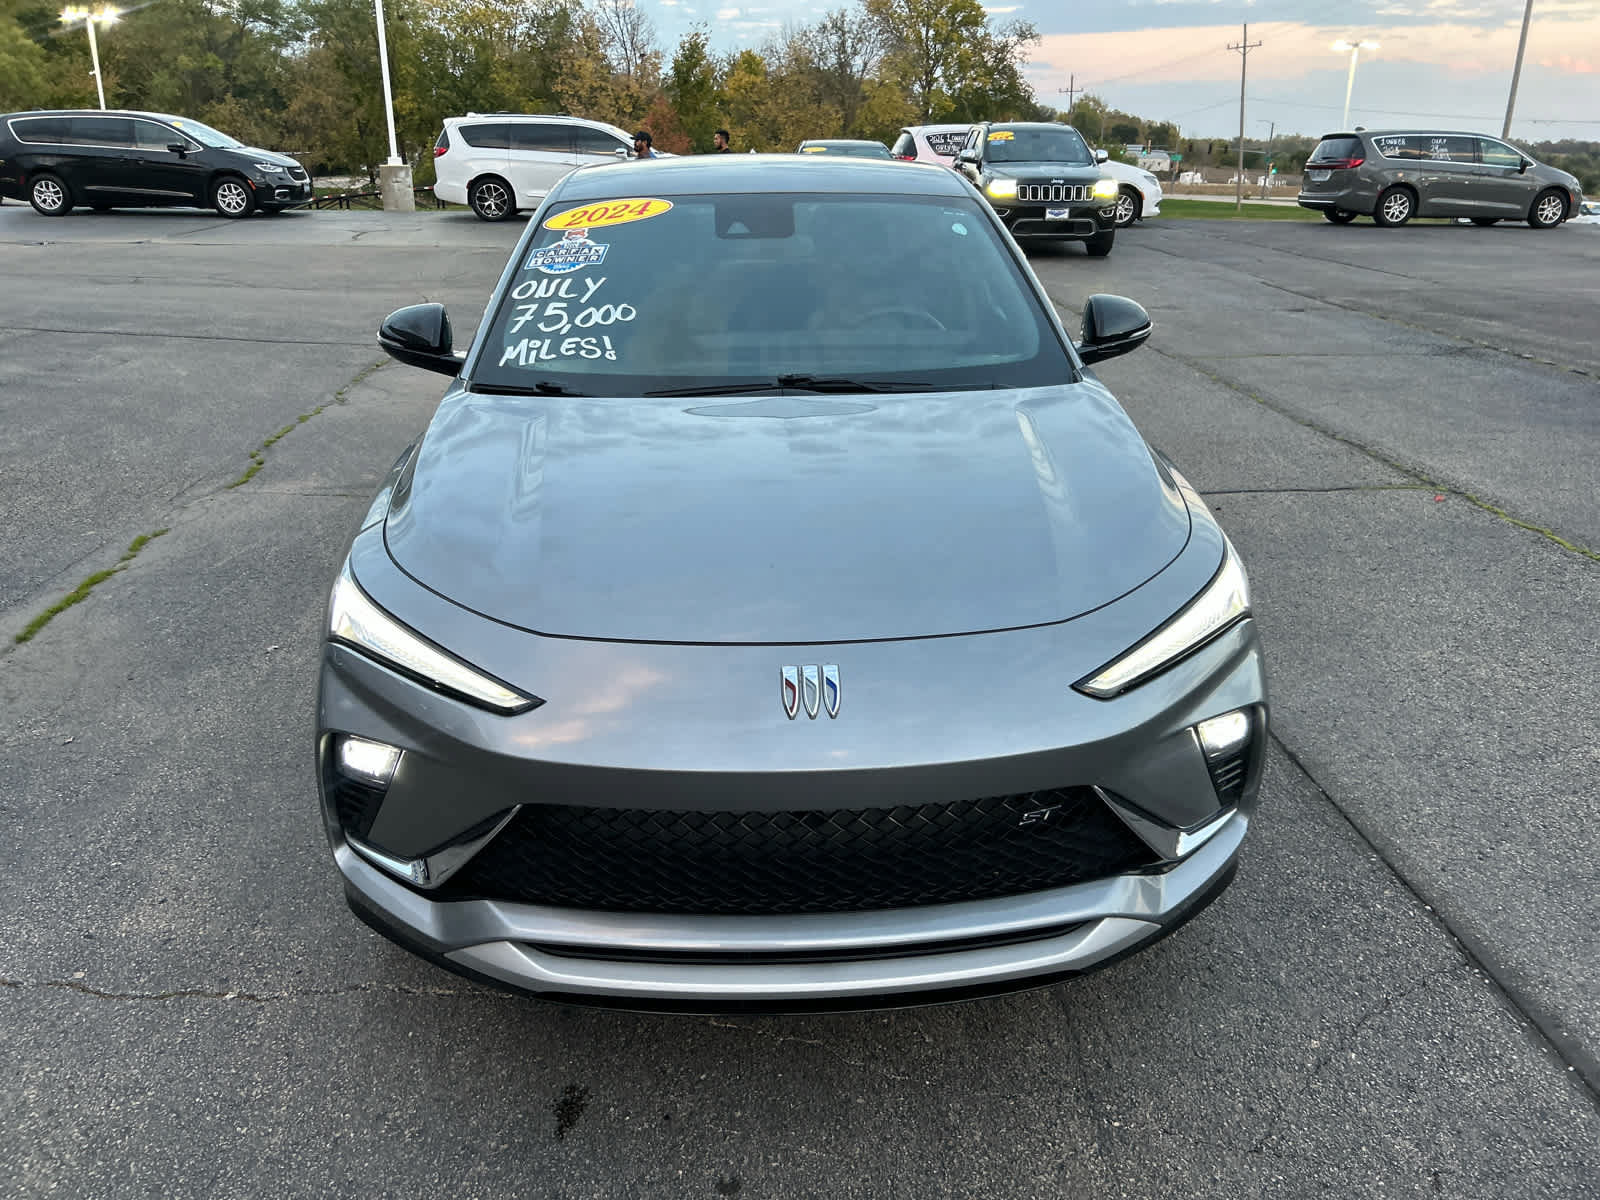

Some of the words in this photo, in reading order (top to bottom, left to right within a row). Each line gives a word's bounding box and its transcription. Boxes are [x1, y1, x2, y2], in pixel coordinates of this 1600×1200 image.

[564, 201, 652, 228] 2024
[536, 246, 605, 258] CARFAX
[543, 255, 600, 265] OWNER
[511, 277, 608, 304] ONLY
[509, 302, 637, 335] 75,000
